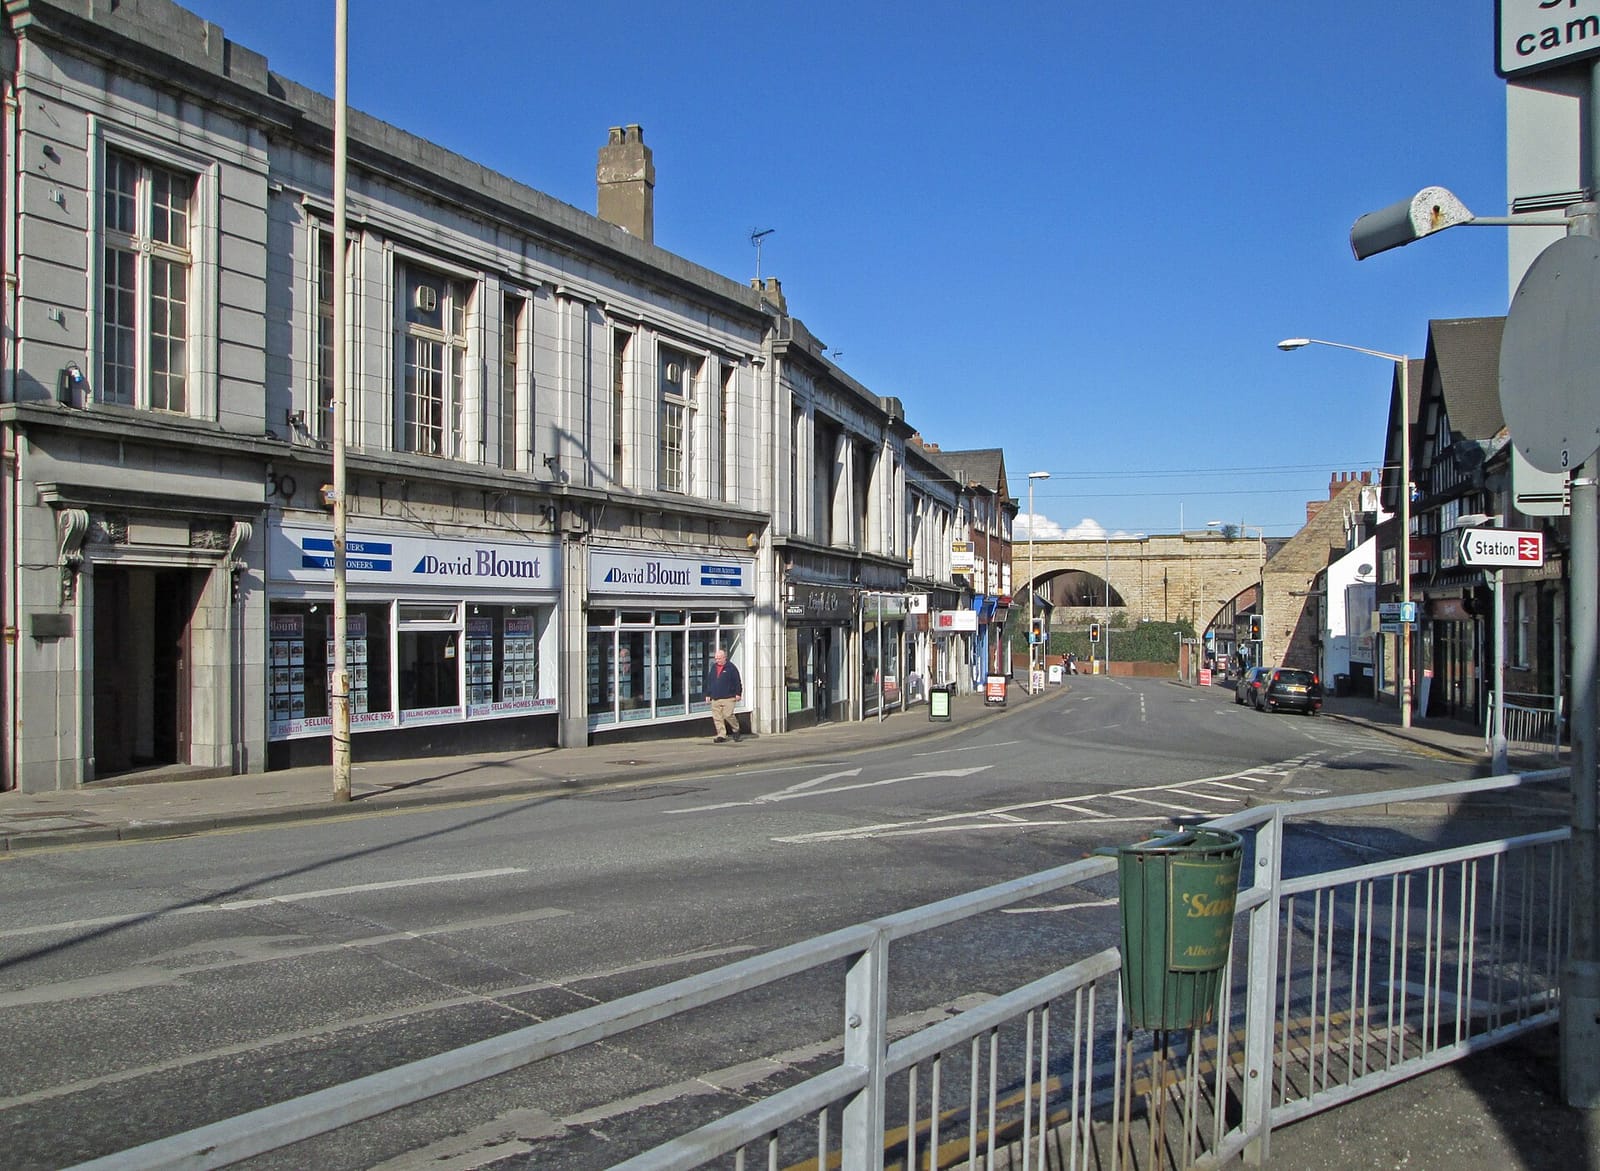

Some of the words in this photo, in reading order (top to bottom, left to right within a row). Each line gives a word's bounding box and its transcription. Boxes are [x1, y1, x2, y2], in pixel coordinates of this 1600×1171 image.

[1561, 451, 1569, 466] 3
[1475, 541, 1515, 557] Station
[323, 557, 373, 569] AUONEERS
[425, 555, 472, 576] David
[475, 550, 541, 578] Blount
[613, 567, 644, 584] David
[645, 562, 691, 586] Blount
[491, 702, 512, 711] SELLING
[513, 701, 531, 709] HOMES
[531, 699, 545, 708] SINCE
[304, 717, 333, 727] SELLING
[360, 713, 379, 722] SINCE
[380, 711, 394, 720] 1995
